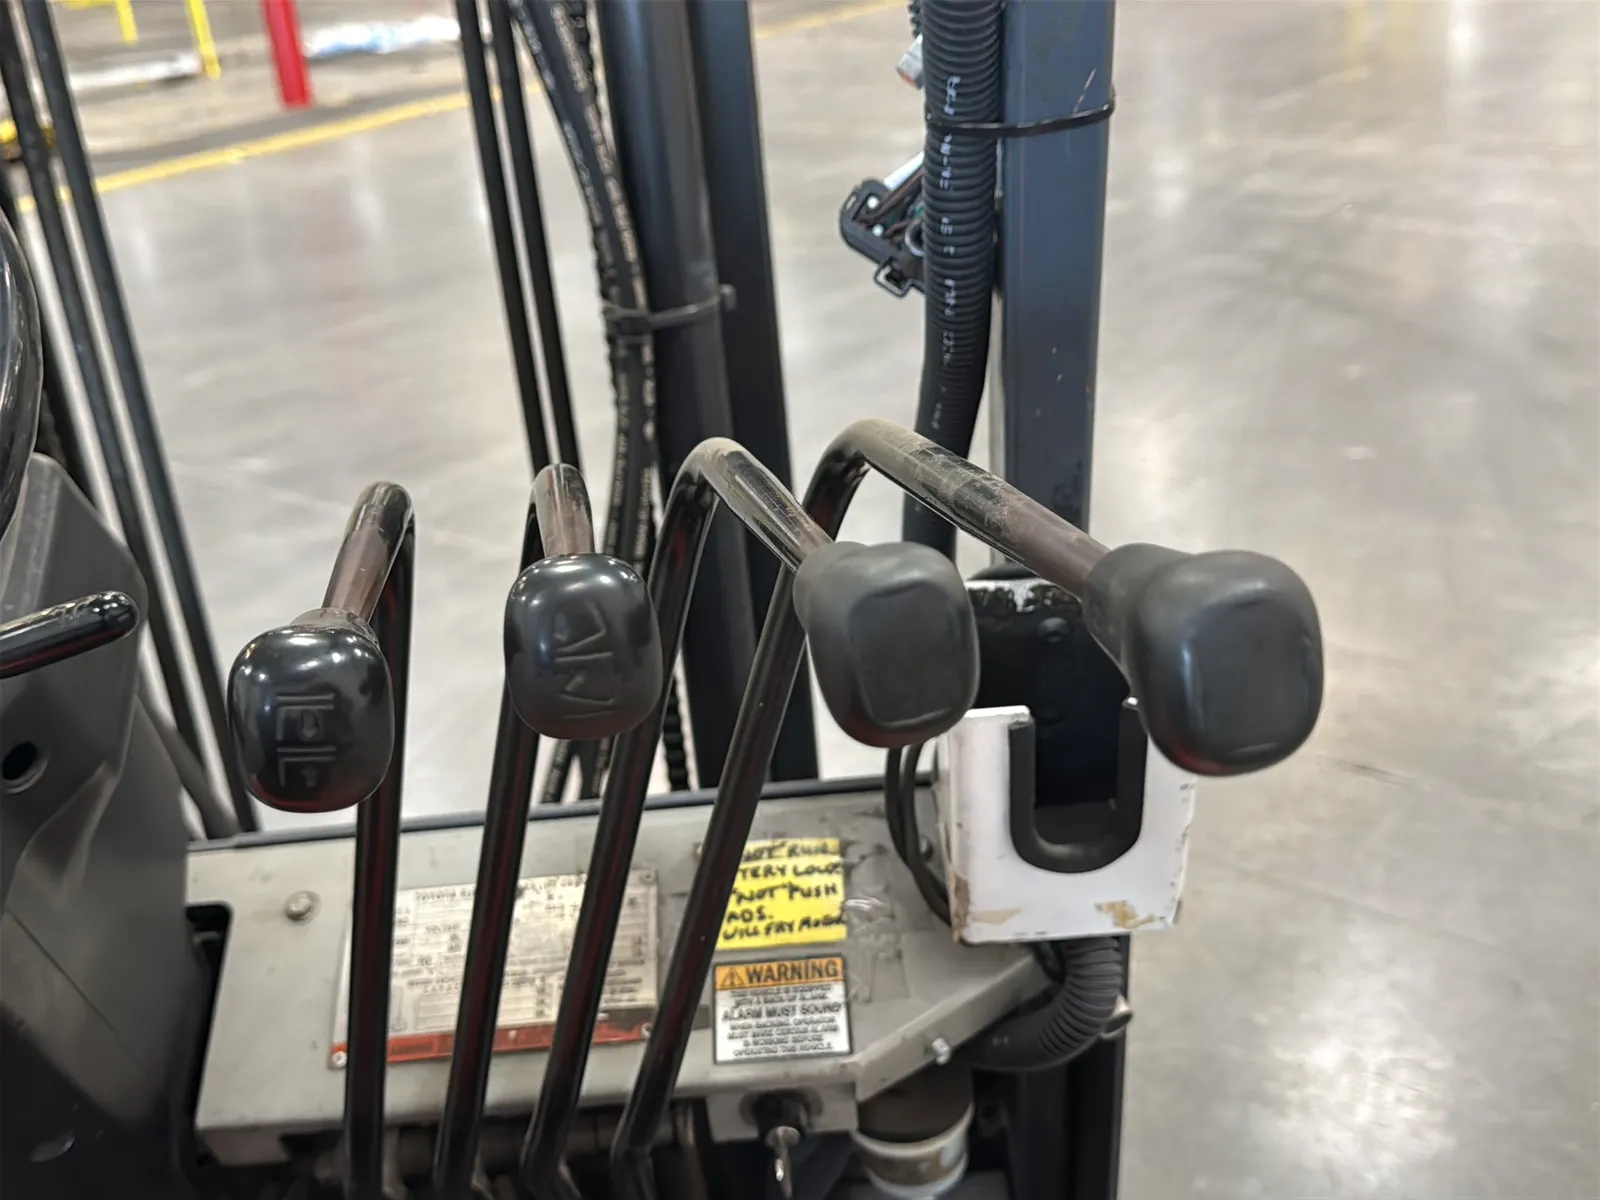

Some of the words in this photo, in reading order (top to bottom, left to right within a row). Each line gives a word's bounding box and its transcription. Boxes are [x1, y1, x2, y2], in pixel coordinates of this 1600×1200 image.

[739, 863, 787, 879] TERY
[727, 905, 773, 923] ADS.
[764, 920, 795, 936] FRY
[746, 960, 838, 983] WARNING
[722, 1007, 762, 1021] ALARM
[765, 1004, 796, 1018] MUST
[800, 1001, 842, 1015] SOUND
